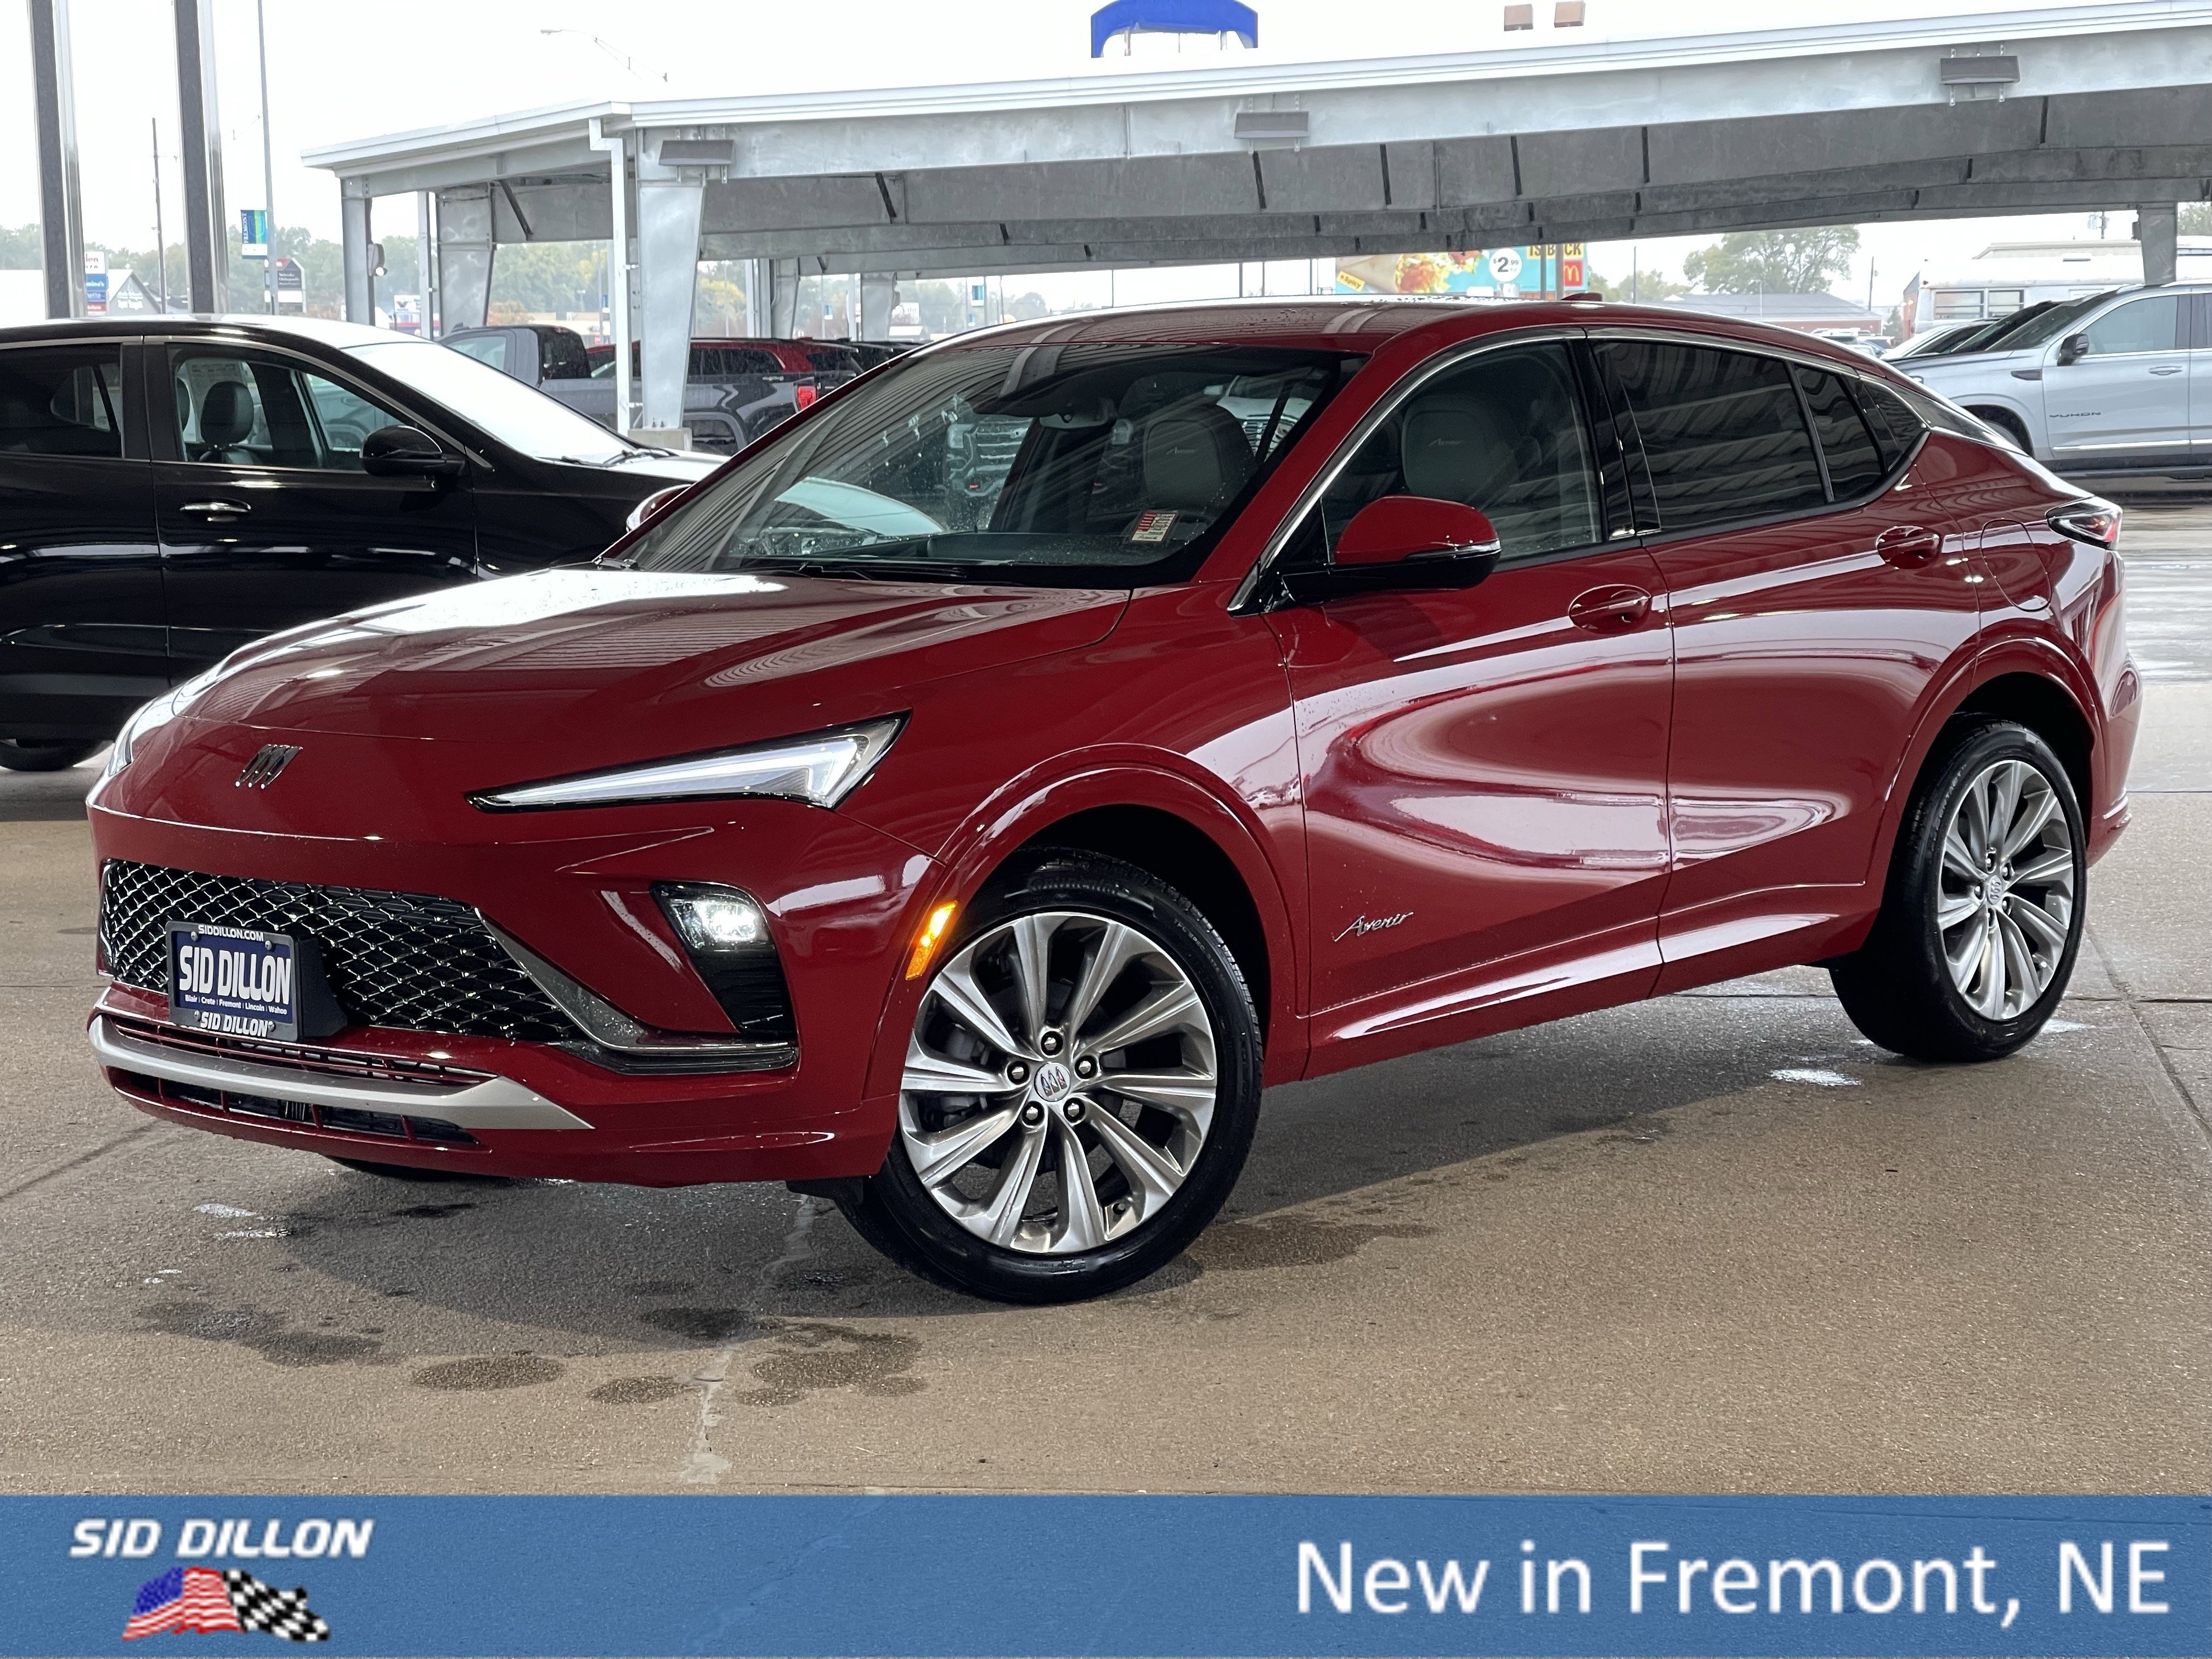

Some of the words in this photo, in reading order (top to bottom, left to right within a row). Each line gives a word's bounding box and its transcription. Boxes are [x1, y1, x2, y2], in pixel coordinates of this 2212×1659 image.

[1547, 243, 1582, 256] BCK
[198, 925, 264, 941] SIDDILLON.COM
[1334, 911, 1414, 942] Avenir
[179, 945, 214, 994] SID
[217, 950, 291, 1005] DILLON
[184, 994, 198, 1003] Blair
[201, 996, 216, 1006] Crete
[219, 998, 241, 1009] Fremont
[245, 1002, 265, 1012] Lincoln
[268, 1005, 287, 1015] Wahoo
[200, 1012, 222, 1030] SID
[223, 1015, 269, 1038] DILLON
